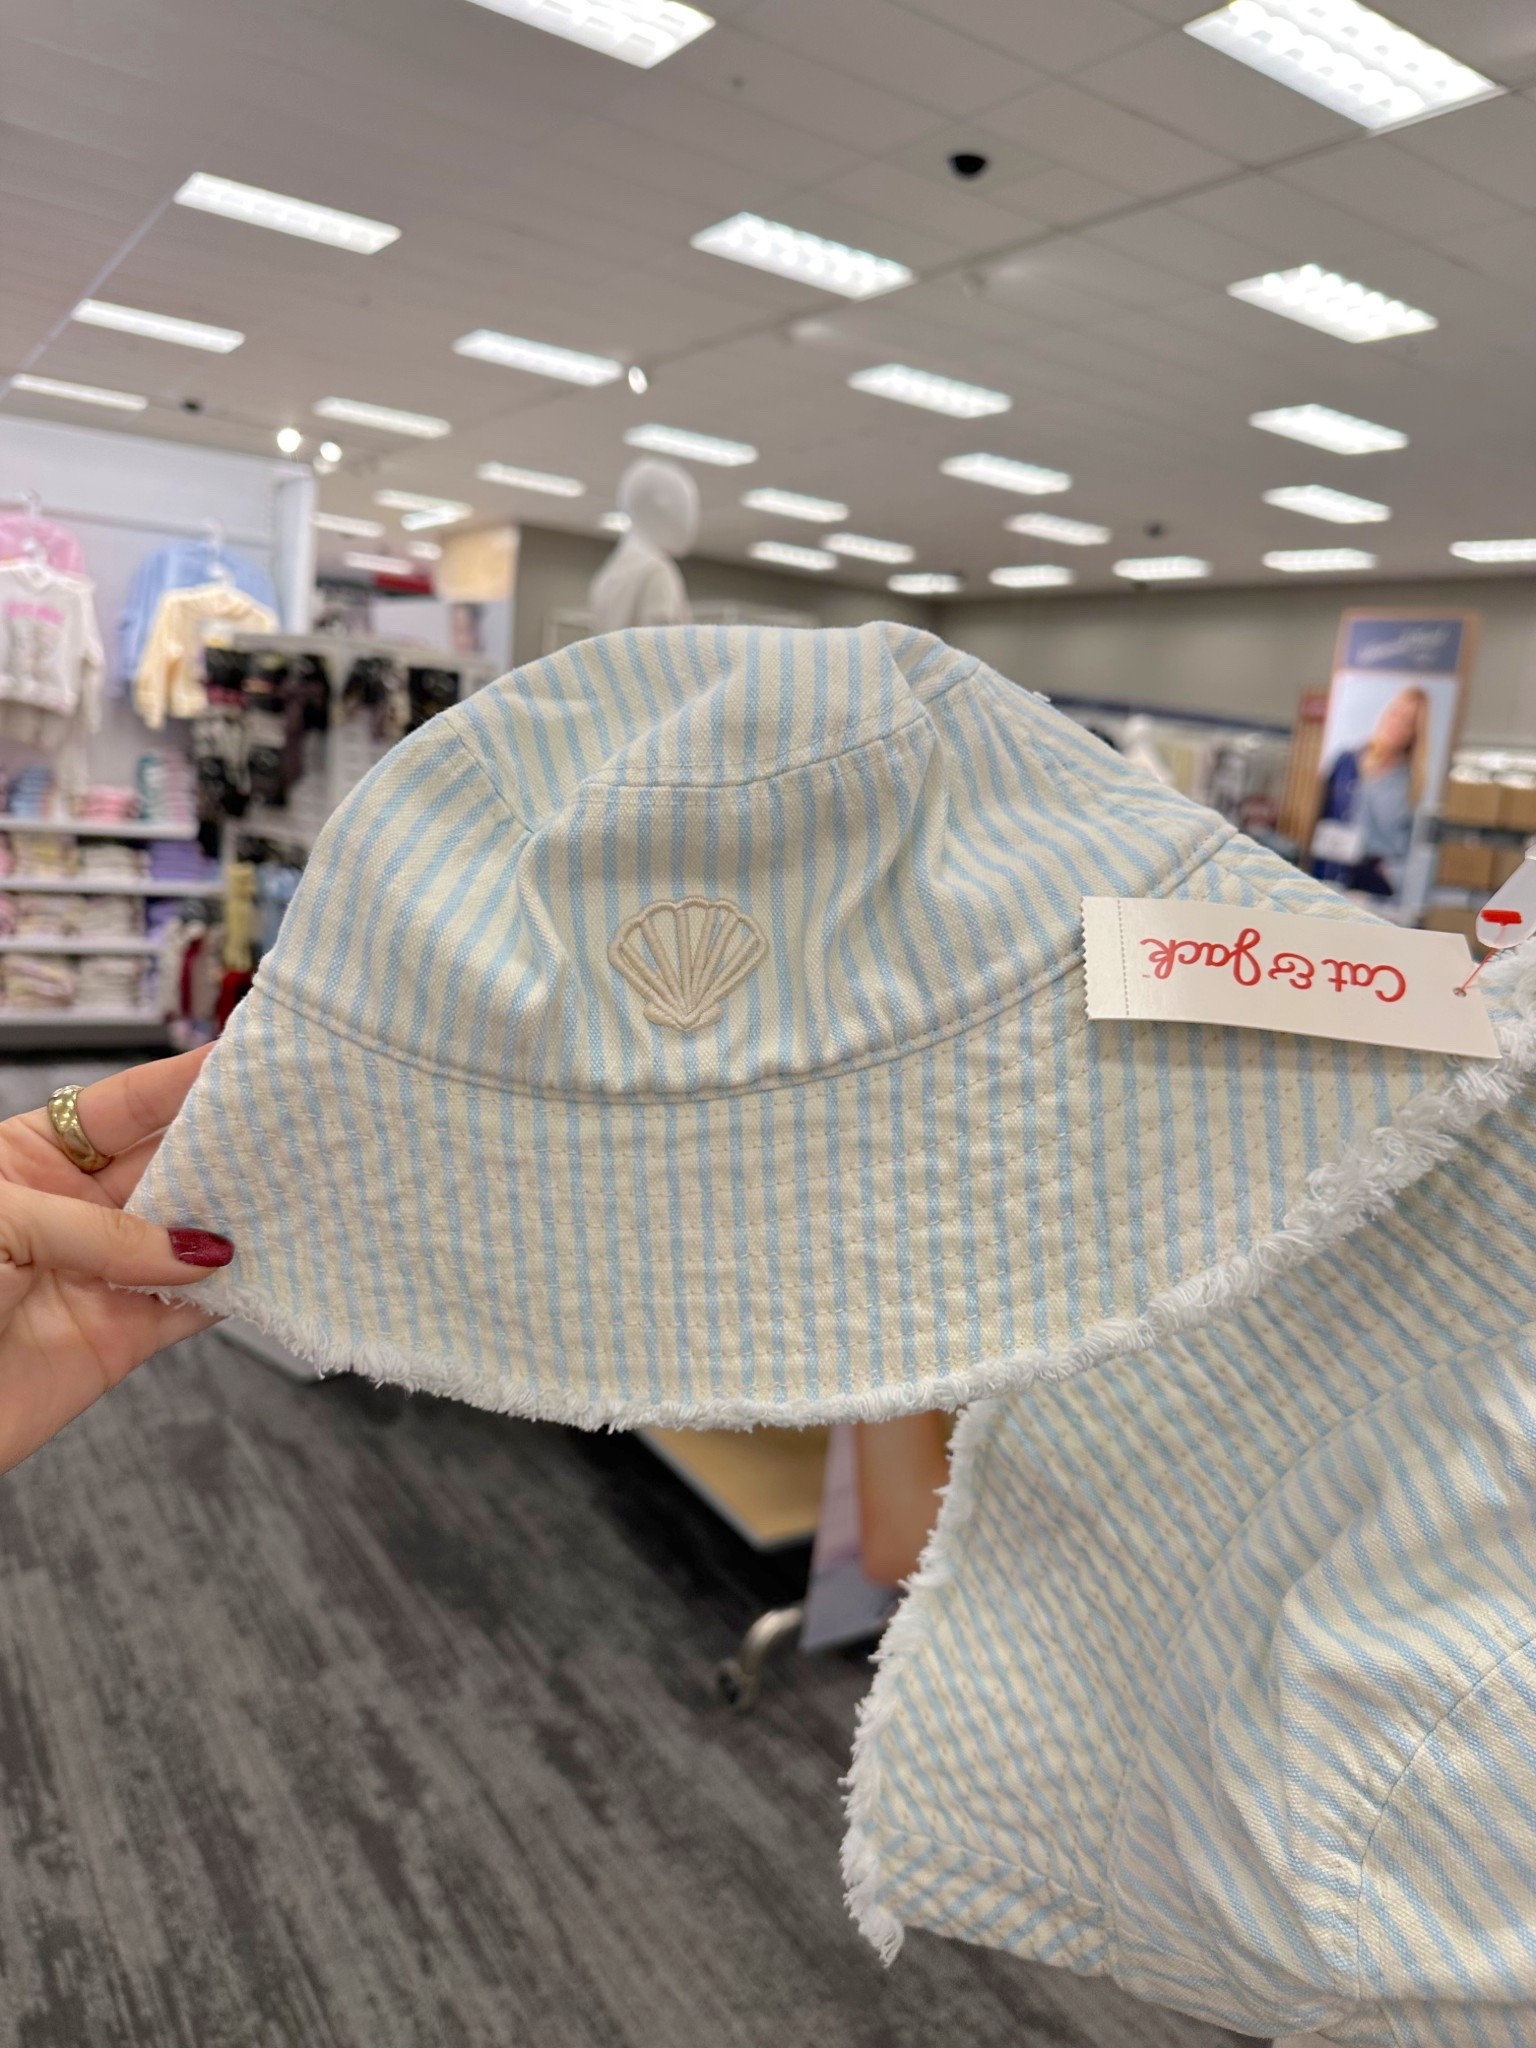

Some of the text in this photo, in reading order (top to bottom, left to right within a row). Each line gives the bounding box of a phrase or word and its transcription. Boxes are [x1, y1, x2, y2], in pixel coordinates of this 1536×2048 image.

[1141, 927, 1407, 1003] Cat & Jack
